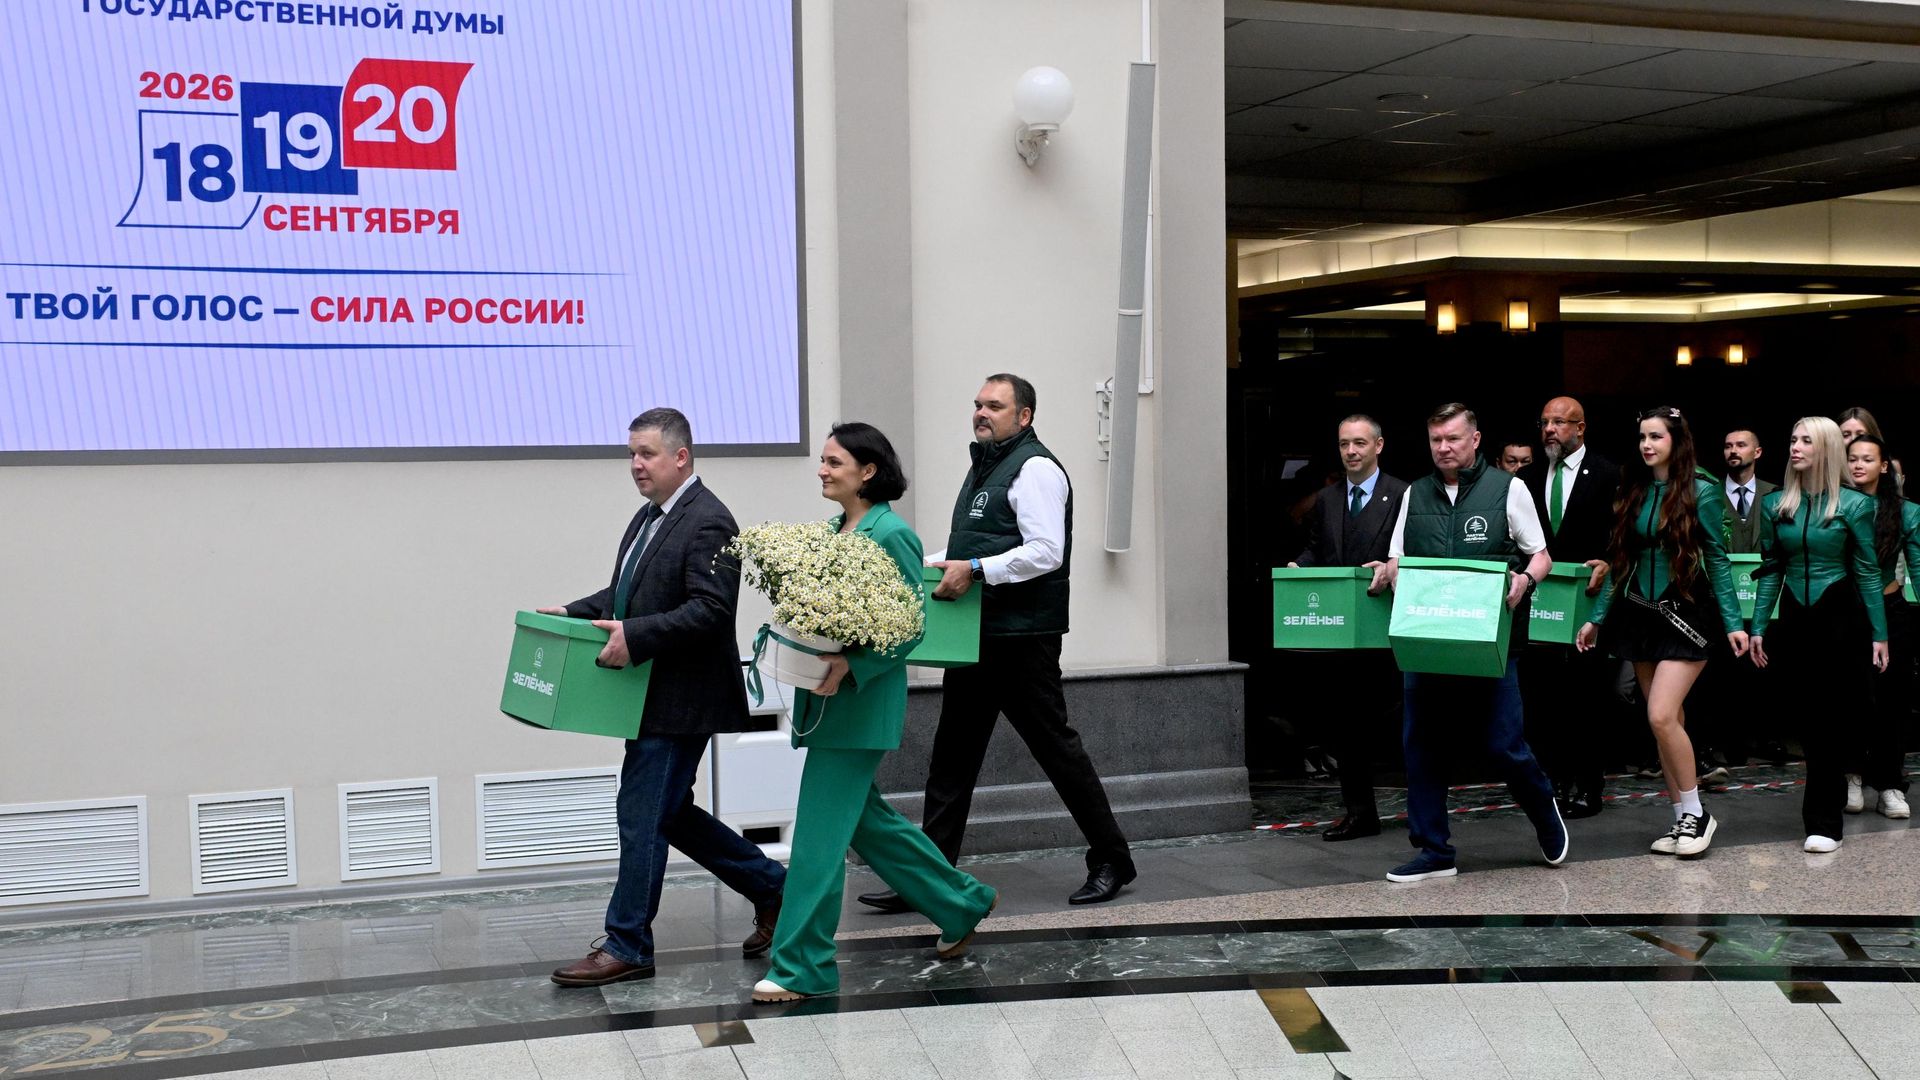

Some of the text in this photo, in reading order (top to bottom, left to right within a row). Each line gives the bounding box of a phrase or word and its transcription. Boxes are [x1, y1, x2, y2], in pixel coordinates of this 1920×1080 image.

[412, 10, 504, 34] ДУМЫ
[139, 72, 233, 101] 2026
[352, 84, 448, 144] 20
[253, 111, 333, 171] 19
[153, 142, 236, 203] 18
[263, 205, 459, 234] СЕНТЯБРЯ
[6, 287, 117, 320] ТВОЙ
[132, 294, 264, 322] ГОЛОС
[310, 296, 414, 323] СИЛА
[425, 298, 584, 325] РОССИИ!
[1283, 612, 1344, 626] ЗЕЛЁНЫЕ
[1406, 604, 1488, 619] ЗЕЛЁНЫЕ
[512, 671, 554, 696] ЗЕЛЁНЫЕ
